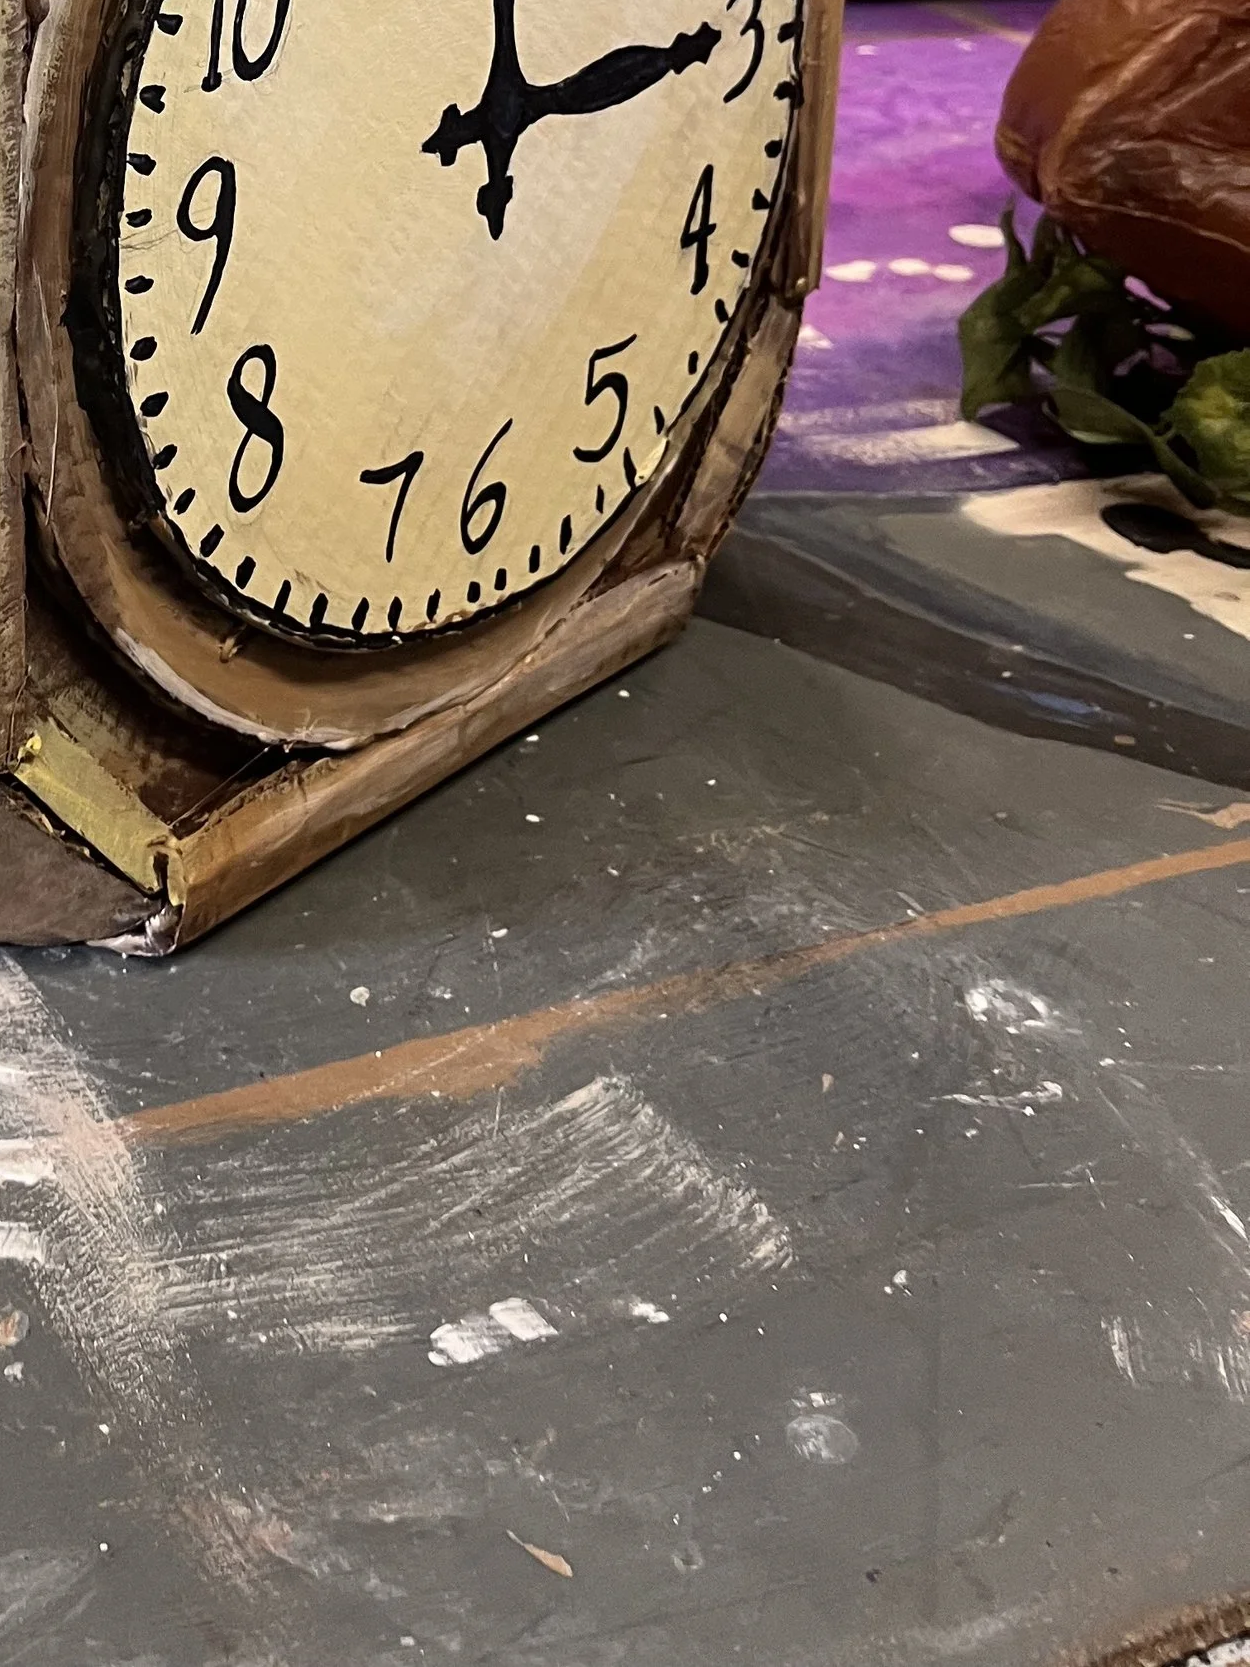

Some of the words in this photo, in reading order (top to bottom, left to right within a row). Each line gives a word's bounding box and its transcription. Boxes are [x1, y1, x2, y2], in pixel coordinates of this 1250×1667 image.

[176, 156, 236, 335] 9
[680, 164, 716, 295] 4
[227, 344, 284, 513] 8
[573, 334, 637, 464] 5
[360, 451, 424, 563] 7
[460, 418, 513, 555] 6
